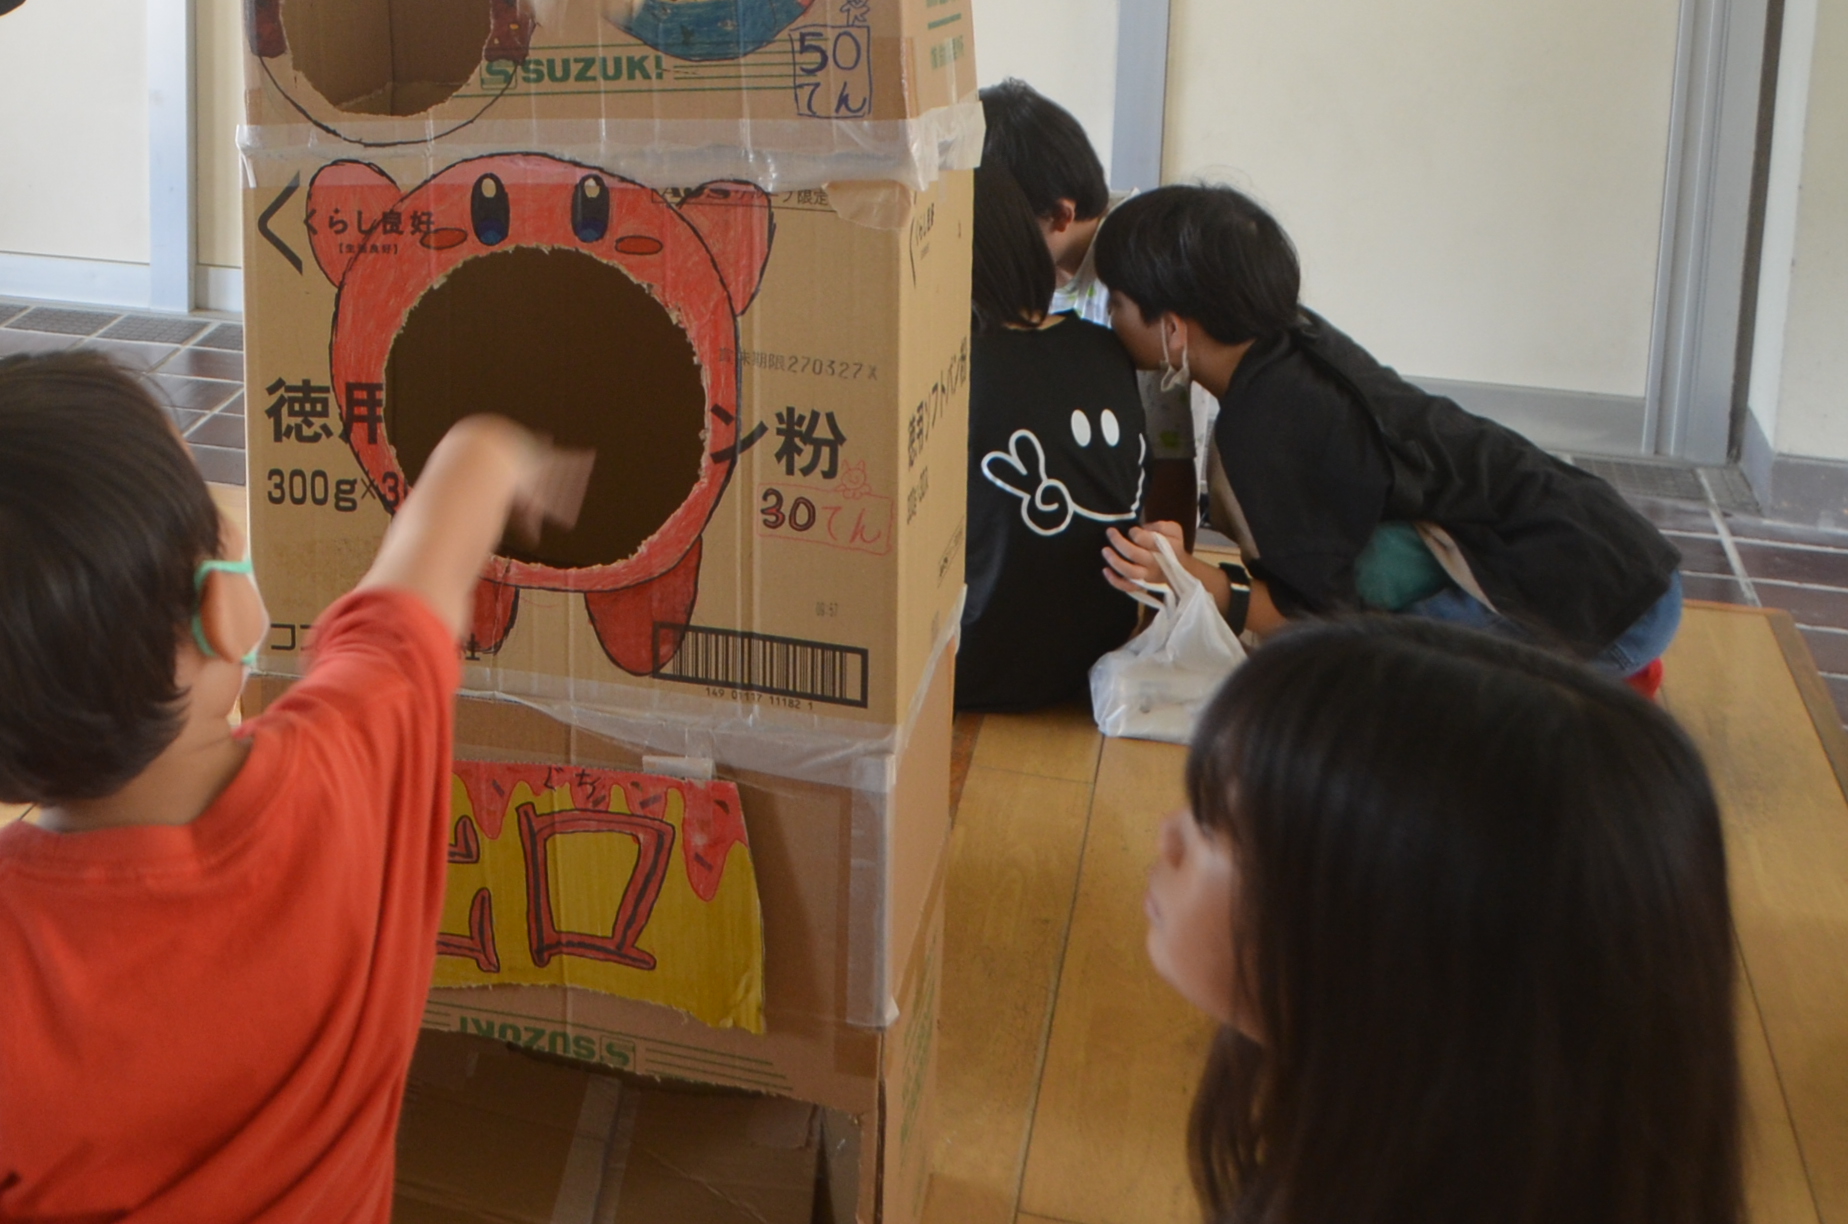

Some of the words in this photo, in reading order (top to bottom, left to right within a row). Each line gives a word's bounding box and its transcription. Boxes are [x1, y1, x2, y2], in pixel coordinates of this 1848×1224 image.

[799, 31, 862, 74] 50
[521, 55, 664, 84] SUZUKI
[795, 81, 867, 116] てん
[303, 208, 434, 235] くらし良好
